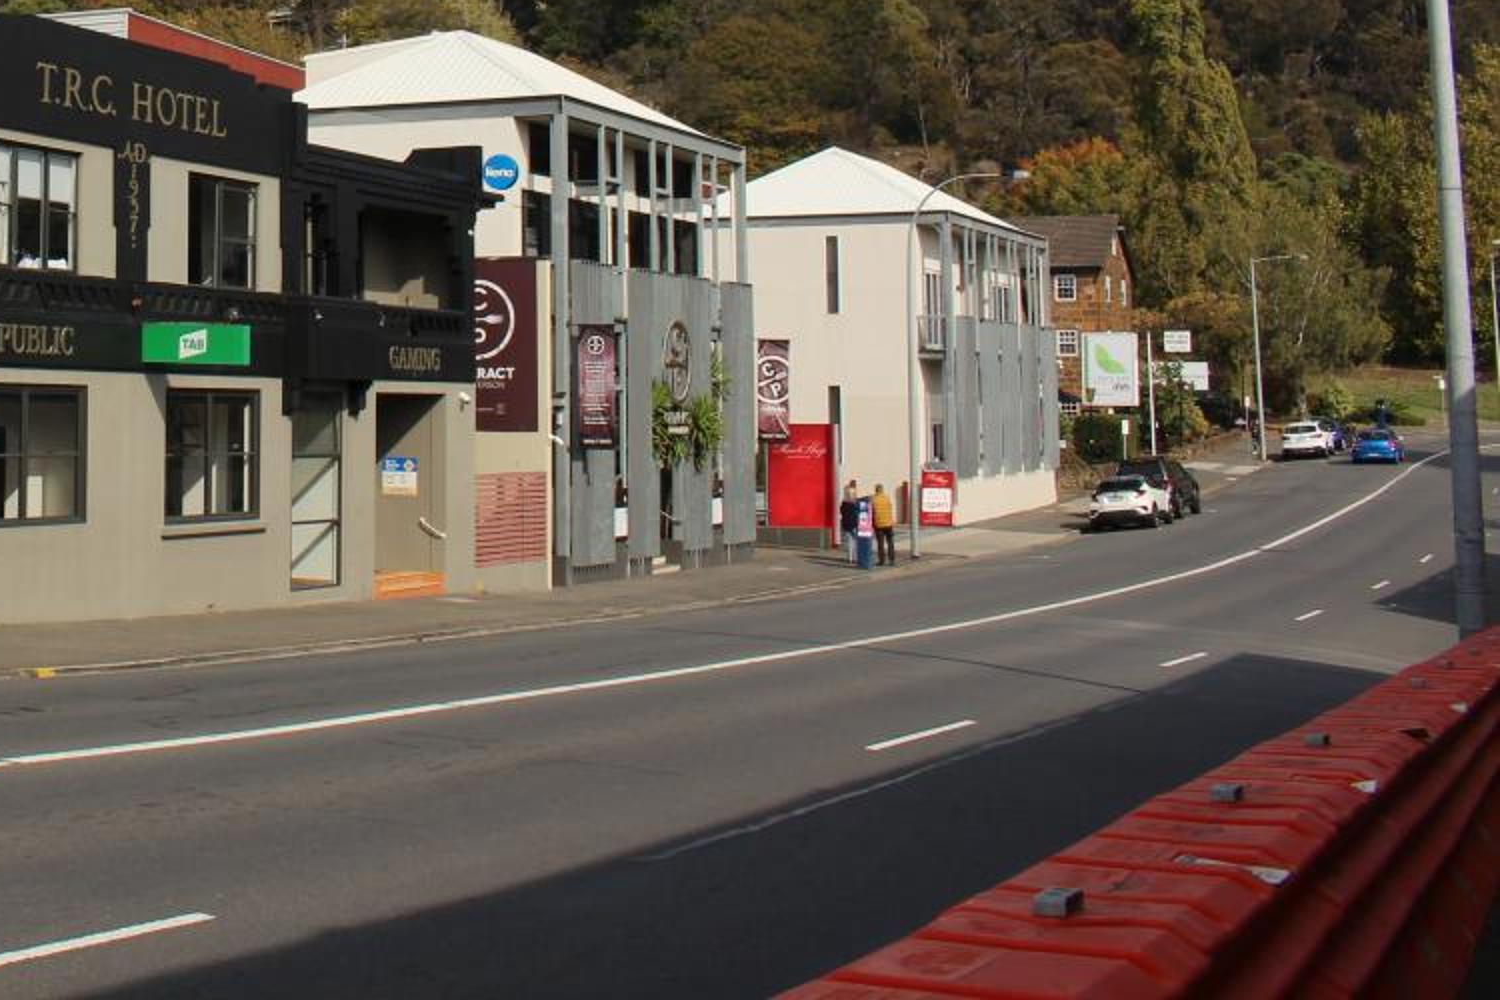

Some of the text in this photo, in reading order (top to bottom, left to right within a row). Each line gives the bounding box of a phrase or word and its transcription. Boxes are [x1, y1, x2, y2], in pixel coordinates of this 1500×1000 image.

[36, 61, 228, 138] T.R.C. HOTEL
[181, 337, 205, 350] TAB
[388, 345, 441, 371] GAMING
